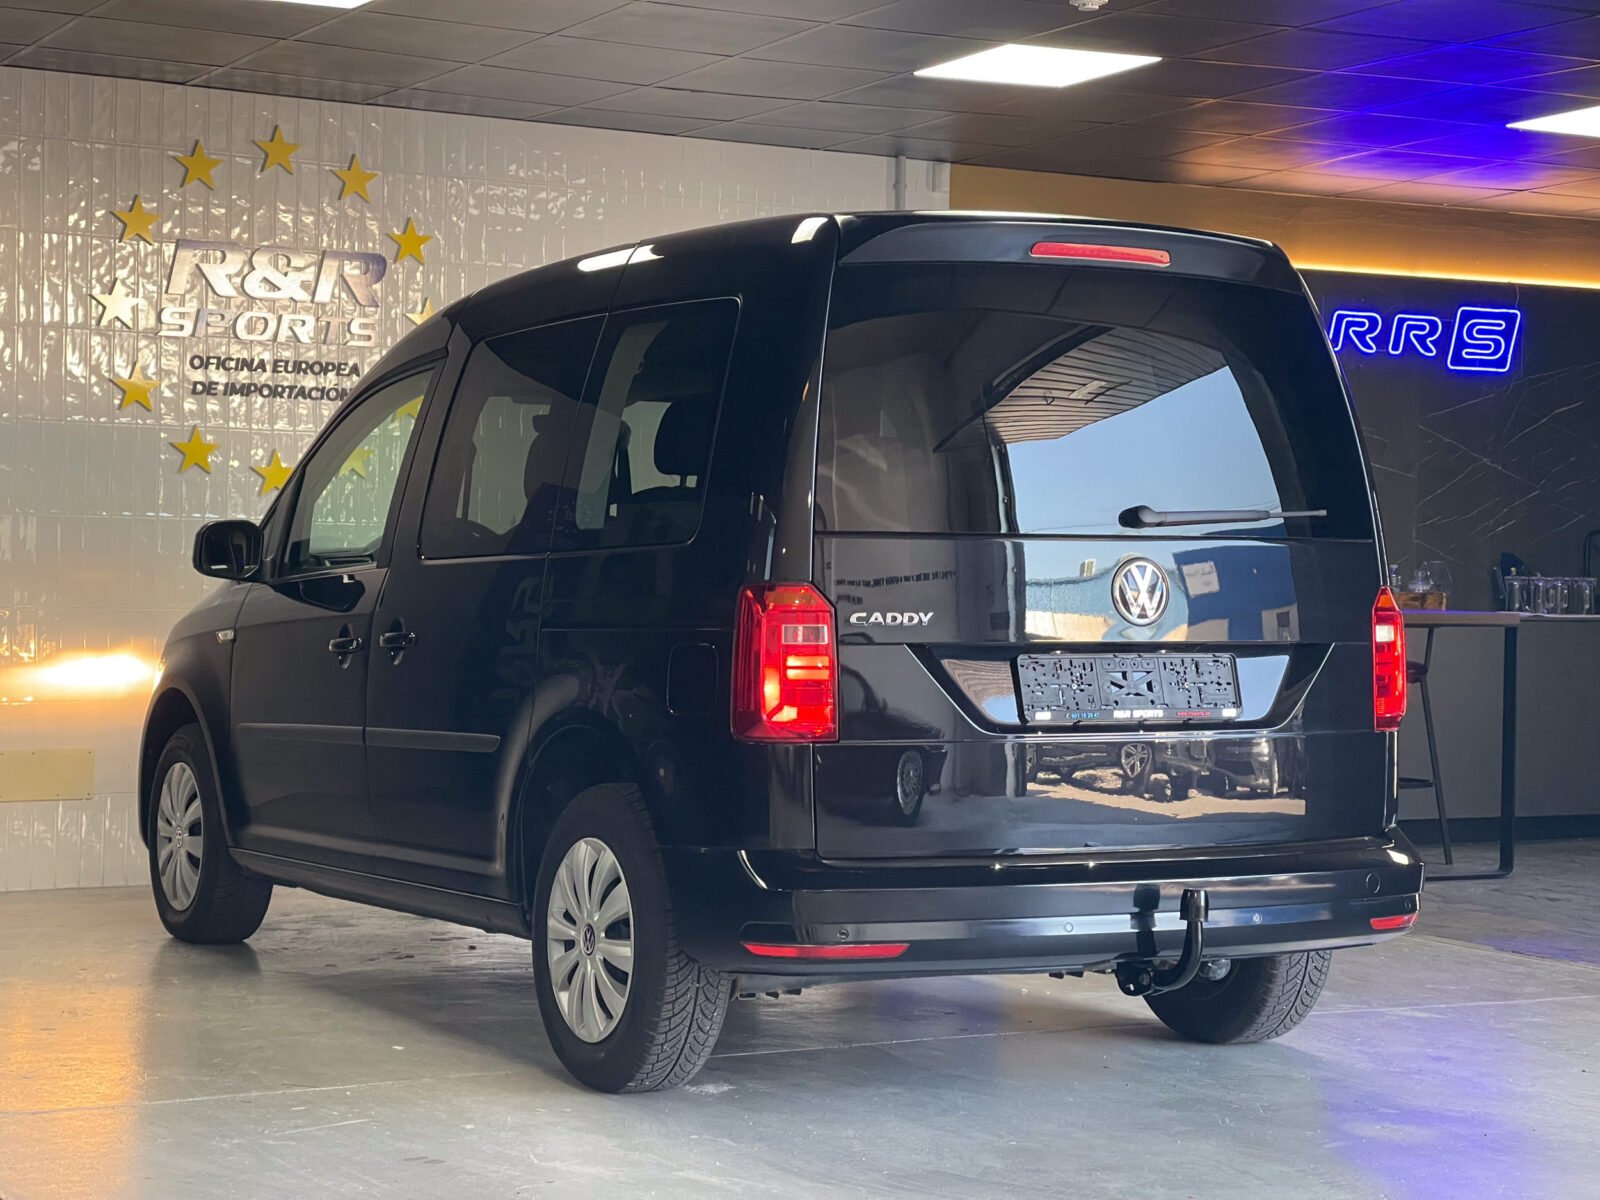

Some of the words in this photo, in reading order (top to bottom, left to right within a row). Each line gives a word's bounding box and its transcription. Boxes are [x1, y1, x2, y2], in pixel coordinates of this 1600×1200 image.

[165, 238, 388, 308] R&R
[155, 306, 382, 347] SPORTS
[189, 354, 267, 373] OFICINA
[271, 358, 361, 378] EUROPEA
[190, 380, 219, 397] DE
[849, 611, 934, 627] CADDY
